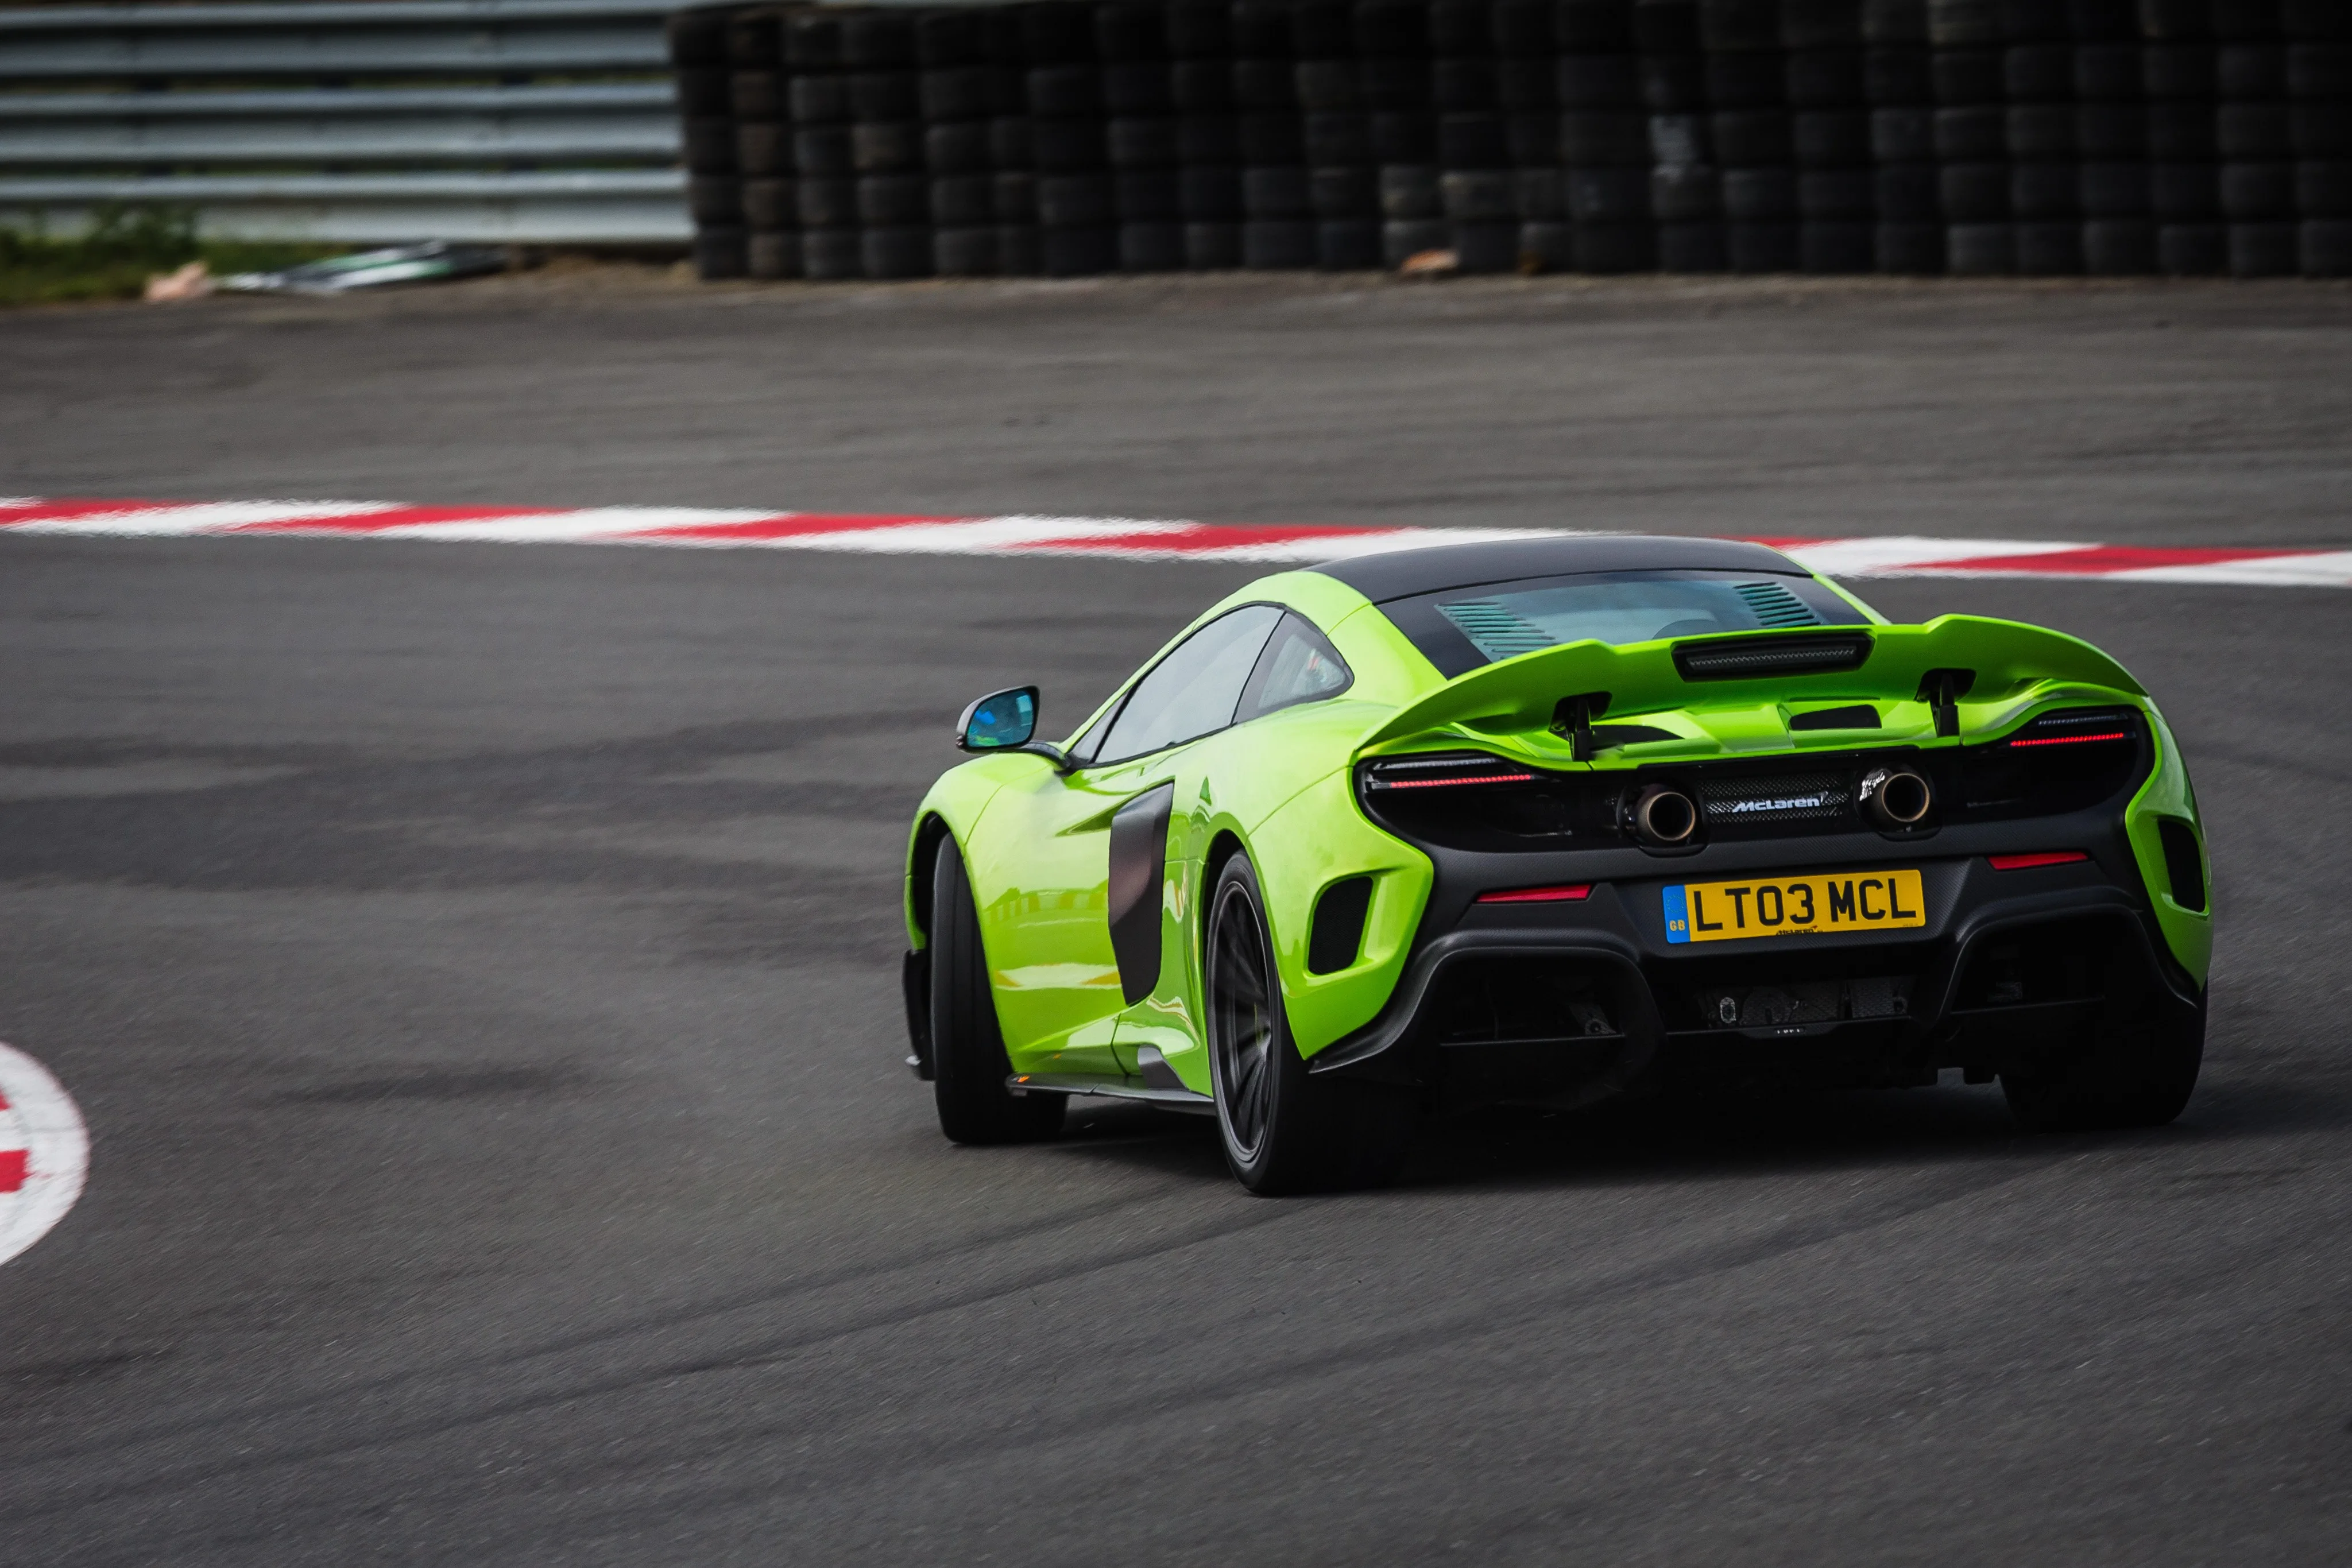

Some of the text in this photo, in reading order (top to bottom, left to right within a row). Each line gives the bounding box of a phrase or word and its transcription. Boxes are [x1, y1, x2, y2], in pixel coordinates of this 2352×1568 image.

[1732, 798, 1820, 813] McLaren
[1693, 878, 1917, 931] LT03 MCL
[1669, 920, 1685, 931] GB
